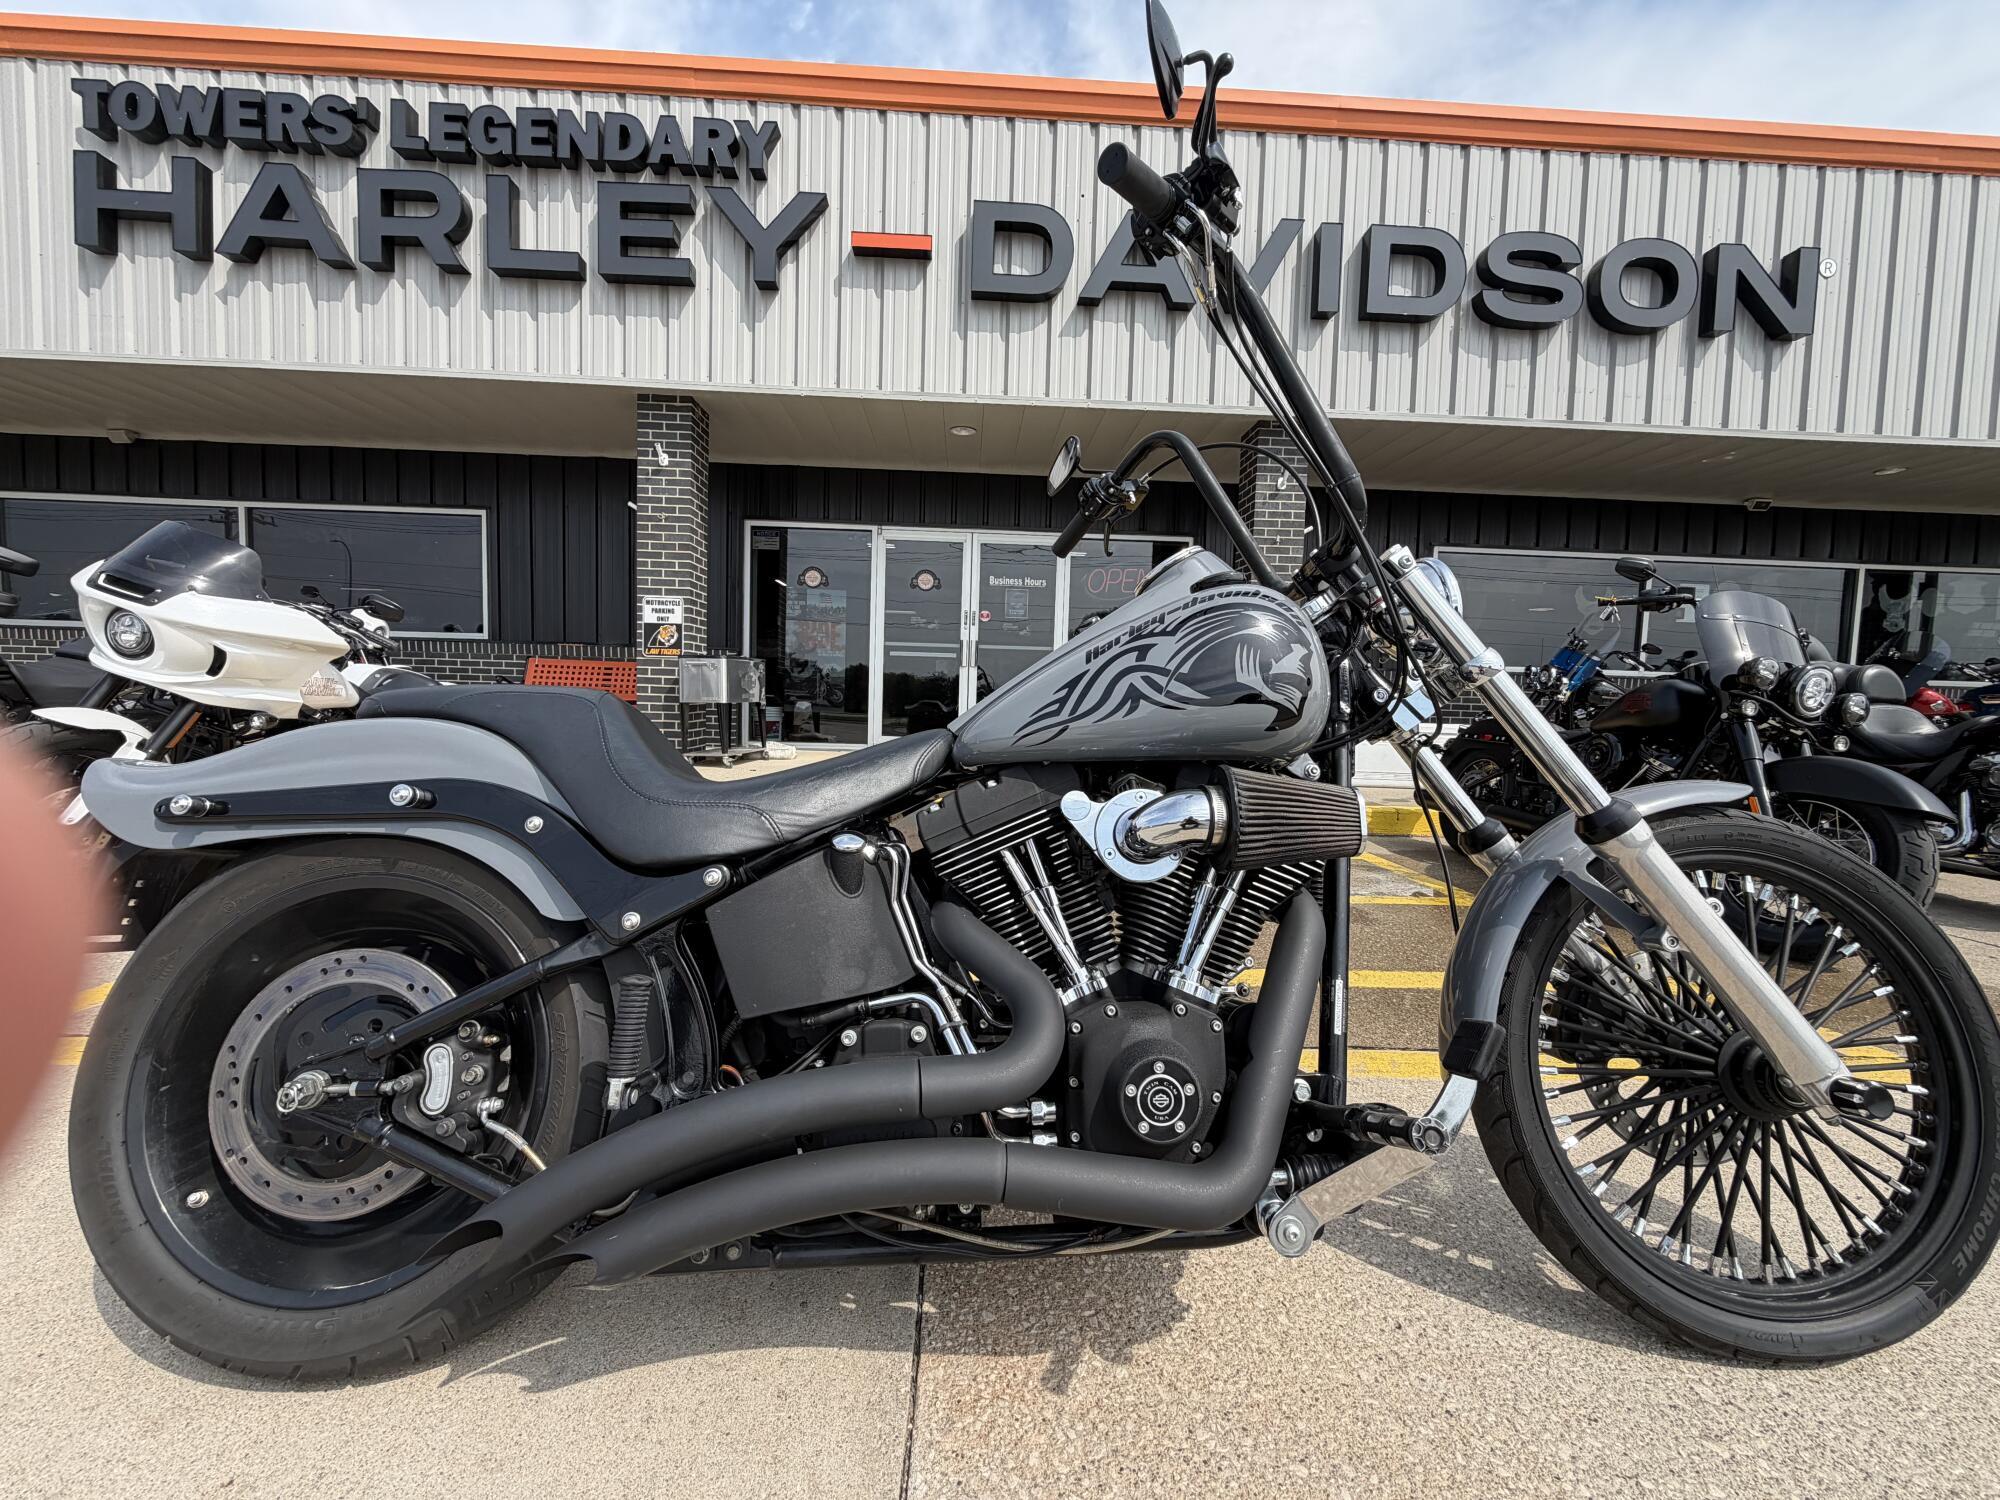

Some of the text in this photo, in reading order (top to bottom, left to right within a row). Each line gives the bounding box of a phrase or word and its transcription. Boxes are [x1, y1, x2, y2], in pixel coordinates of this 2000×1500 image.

[390, 98, 781, 181] LEGENDARY
[73, 150, 830, 291] HARLEY
[970, 199, 1822, 343] DAVIDSON
[989, 575, 1047, 587] Business Hours
[645, 599, 681, 607] MOTORCYCLE
[660, 648, 681, 656] TIGERS
[1143, 1081, 1178, 1095] TWIN CAM
[1951, 1172, 2000, 1277] CHROME
